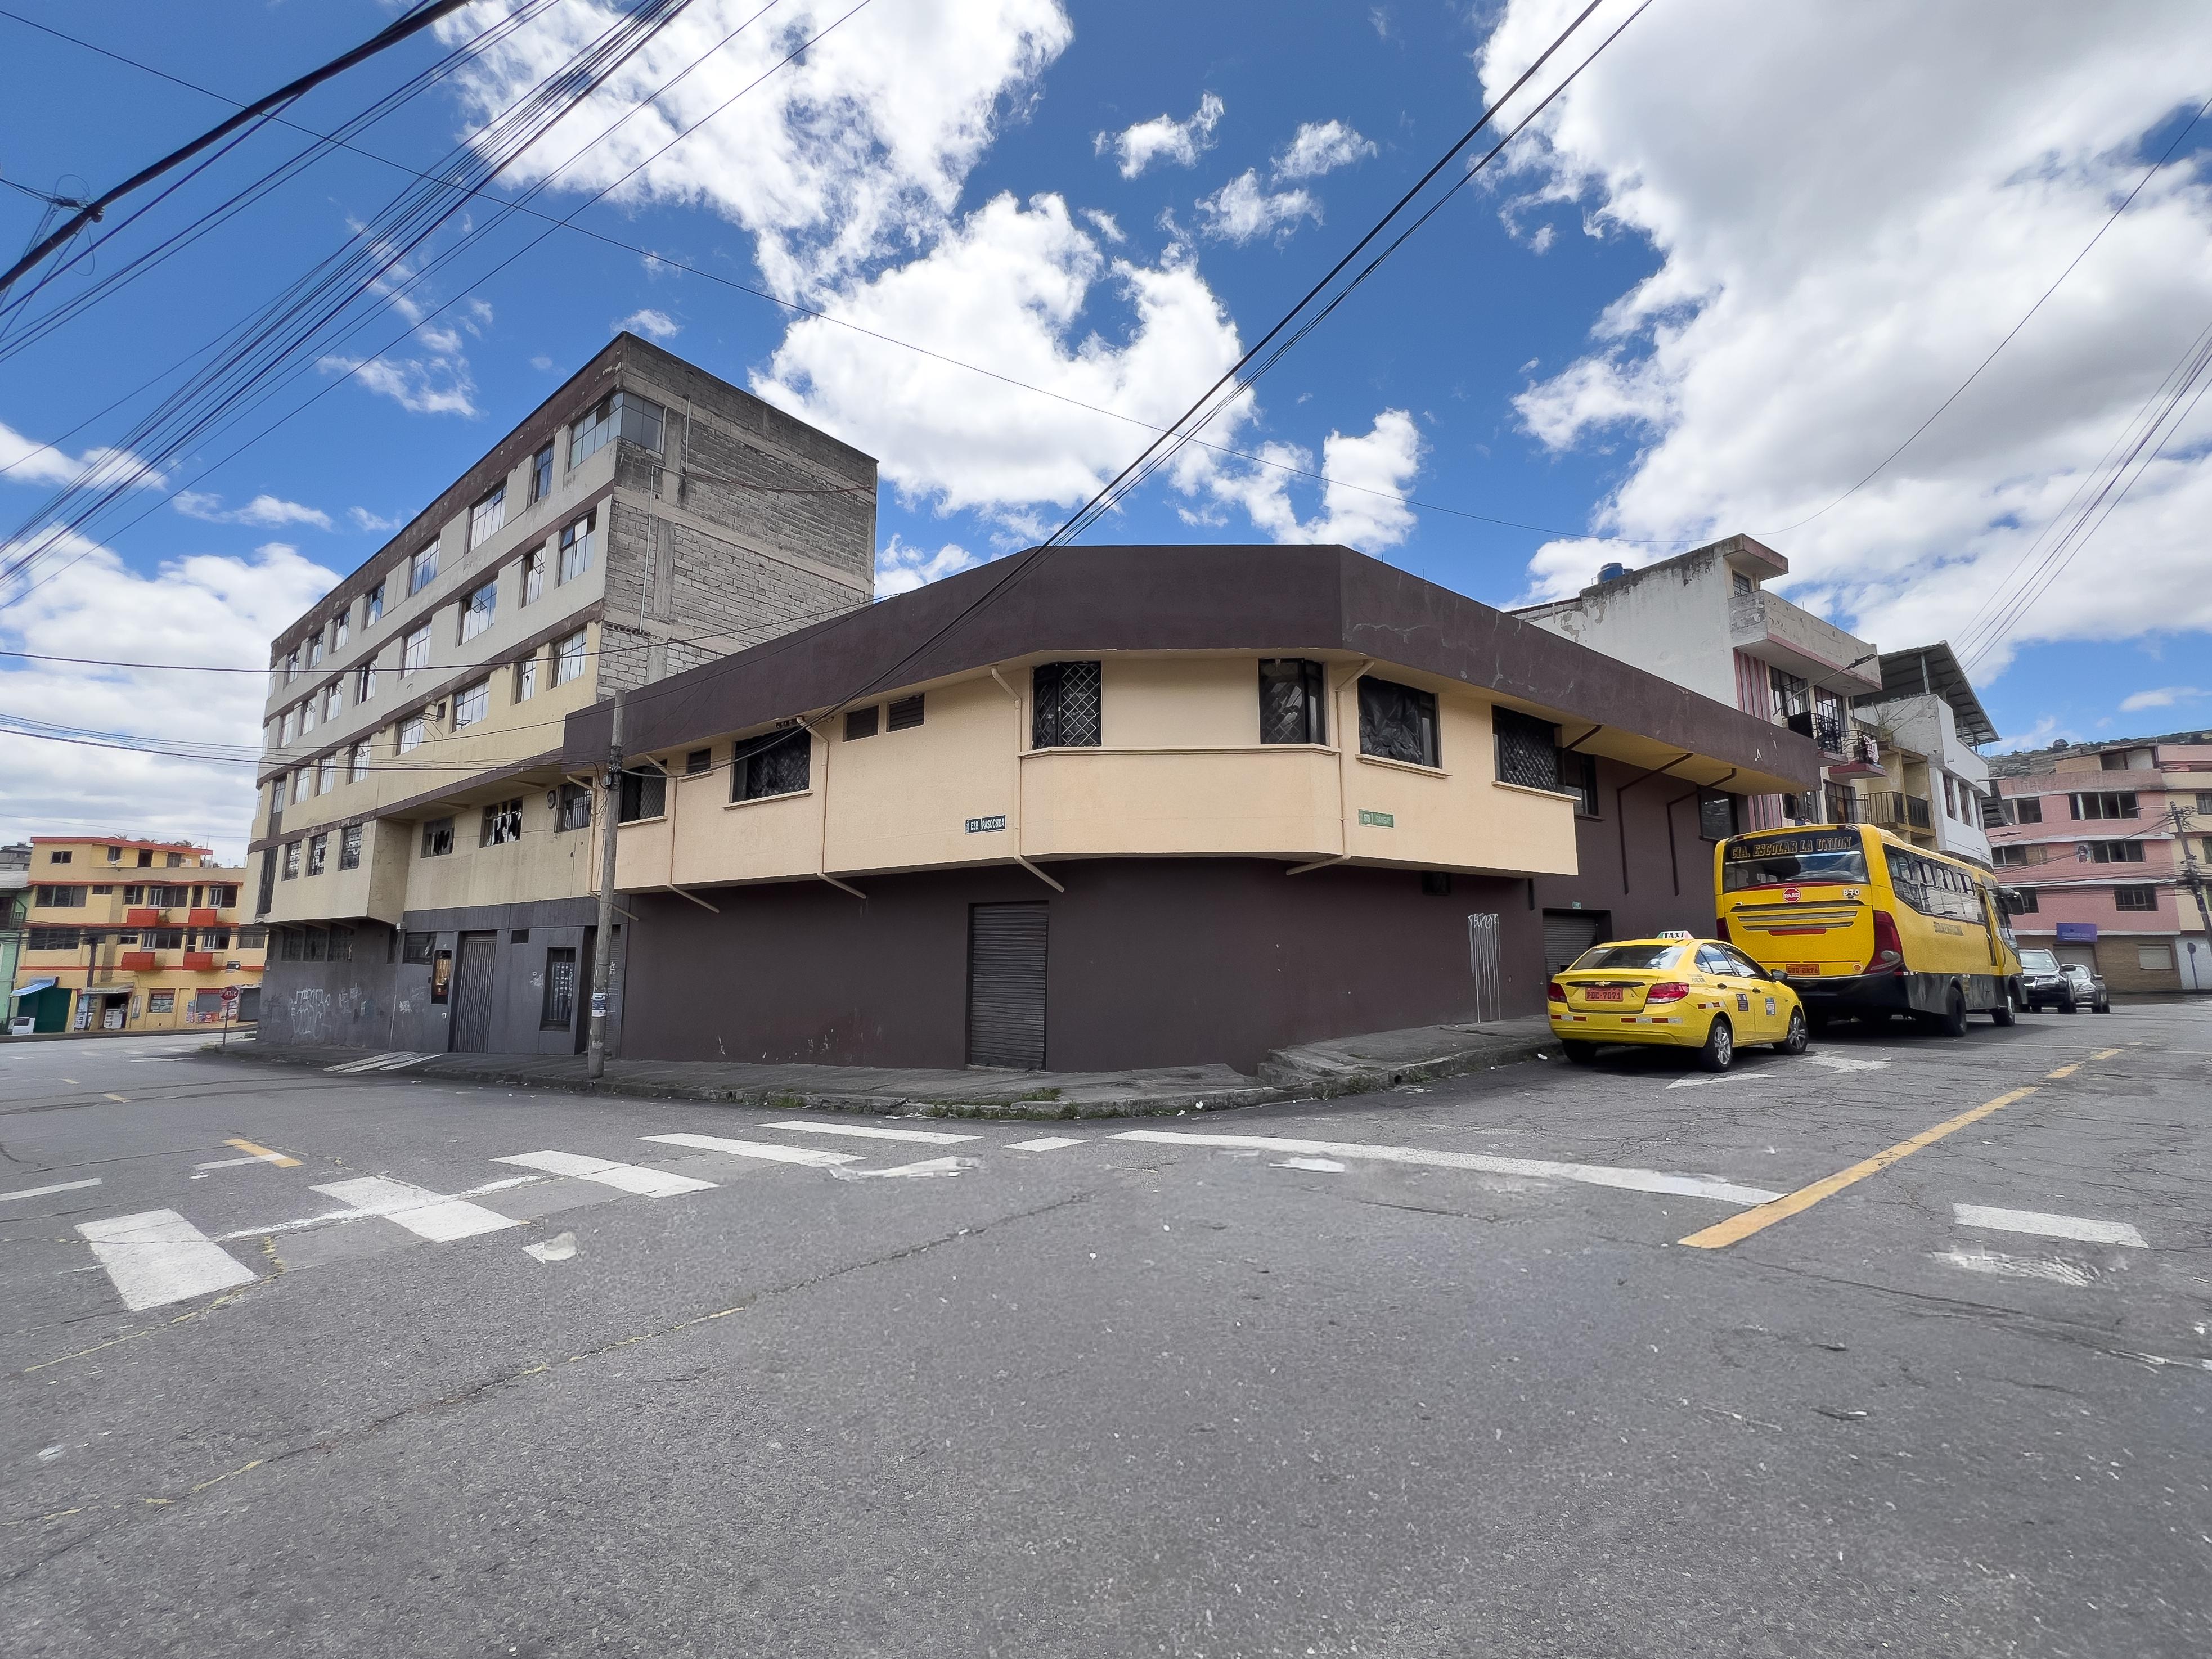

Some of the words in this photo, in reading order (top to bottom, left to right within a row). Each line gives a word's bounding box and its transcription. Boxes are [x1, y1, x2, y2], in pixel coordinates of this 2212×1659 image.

[982, 818, 1004, 829] PASOCHOA
[1753, 841, 1797, 857] ESCOLAR
[1800, 840, 1813, 852] LA
[1817, 837, 1851, 851] UNION
